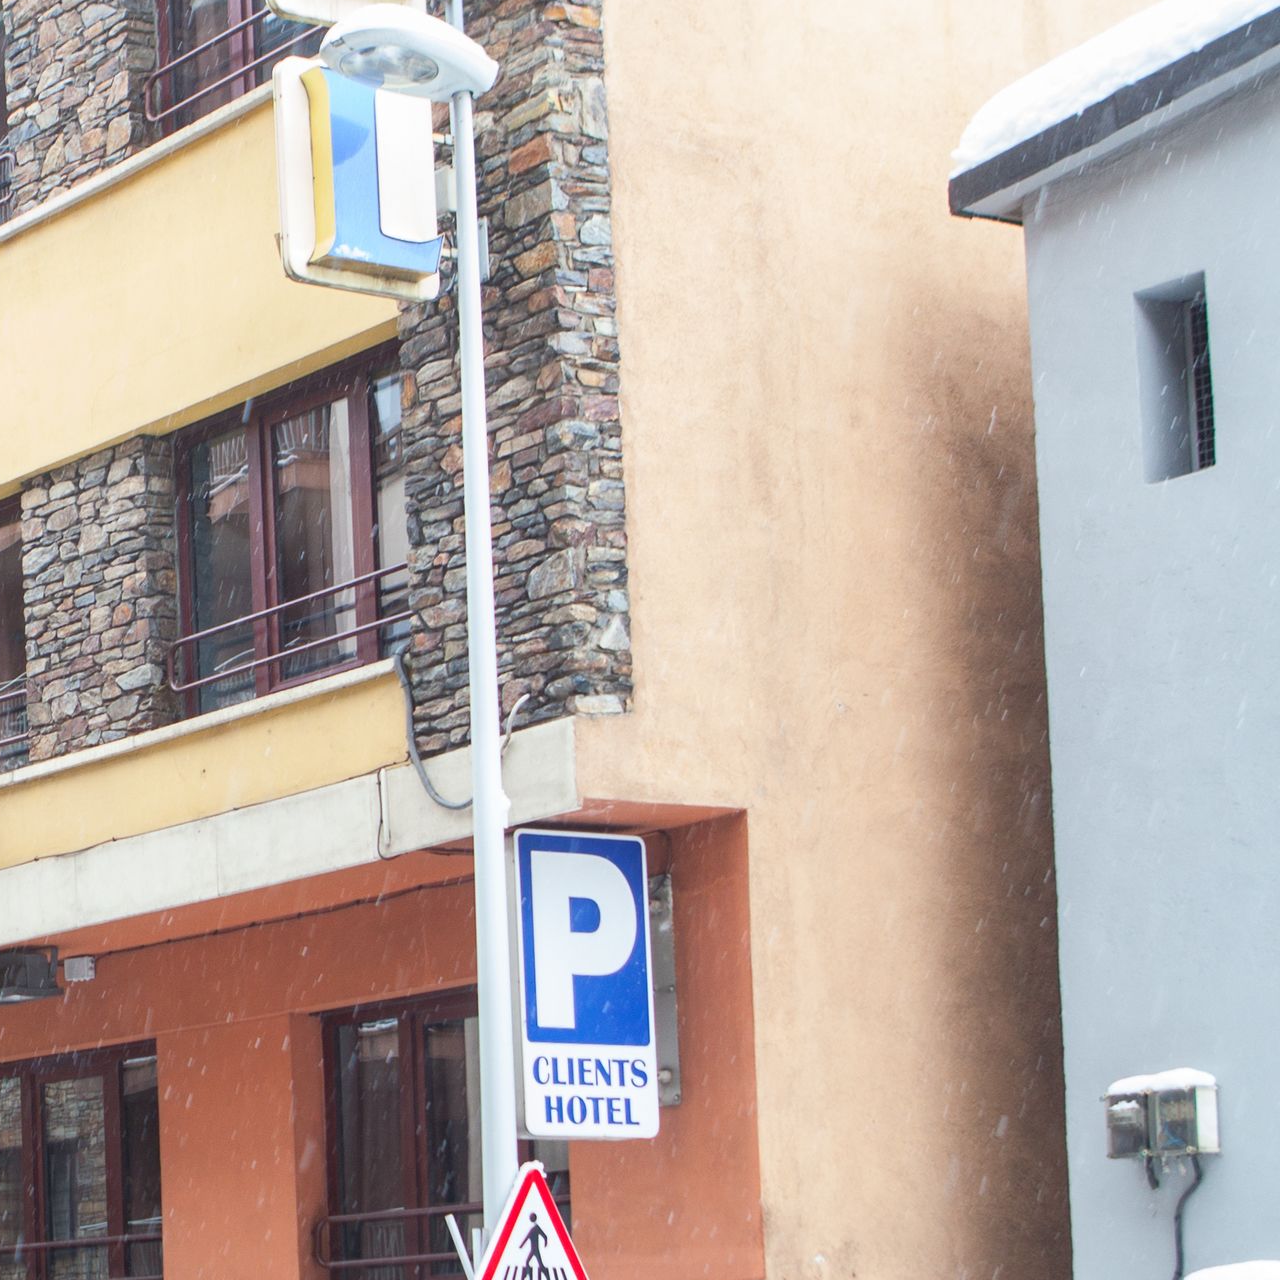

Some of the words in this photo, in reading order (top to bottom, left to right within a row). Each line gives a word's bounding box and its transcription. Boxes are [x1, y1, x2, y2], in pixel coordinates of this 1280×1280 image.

[530, 850, 638, 1029] P
[532, 1055, 648, 1088] CLIENTS
[544, 1095, 640, 1125] HOTEL
